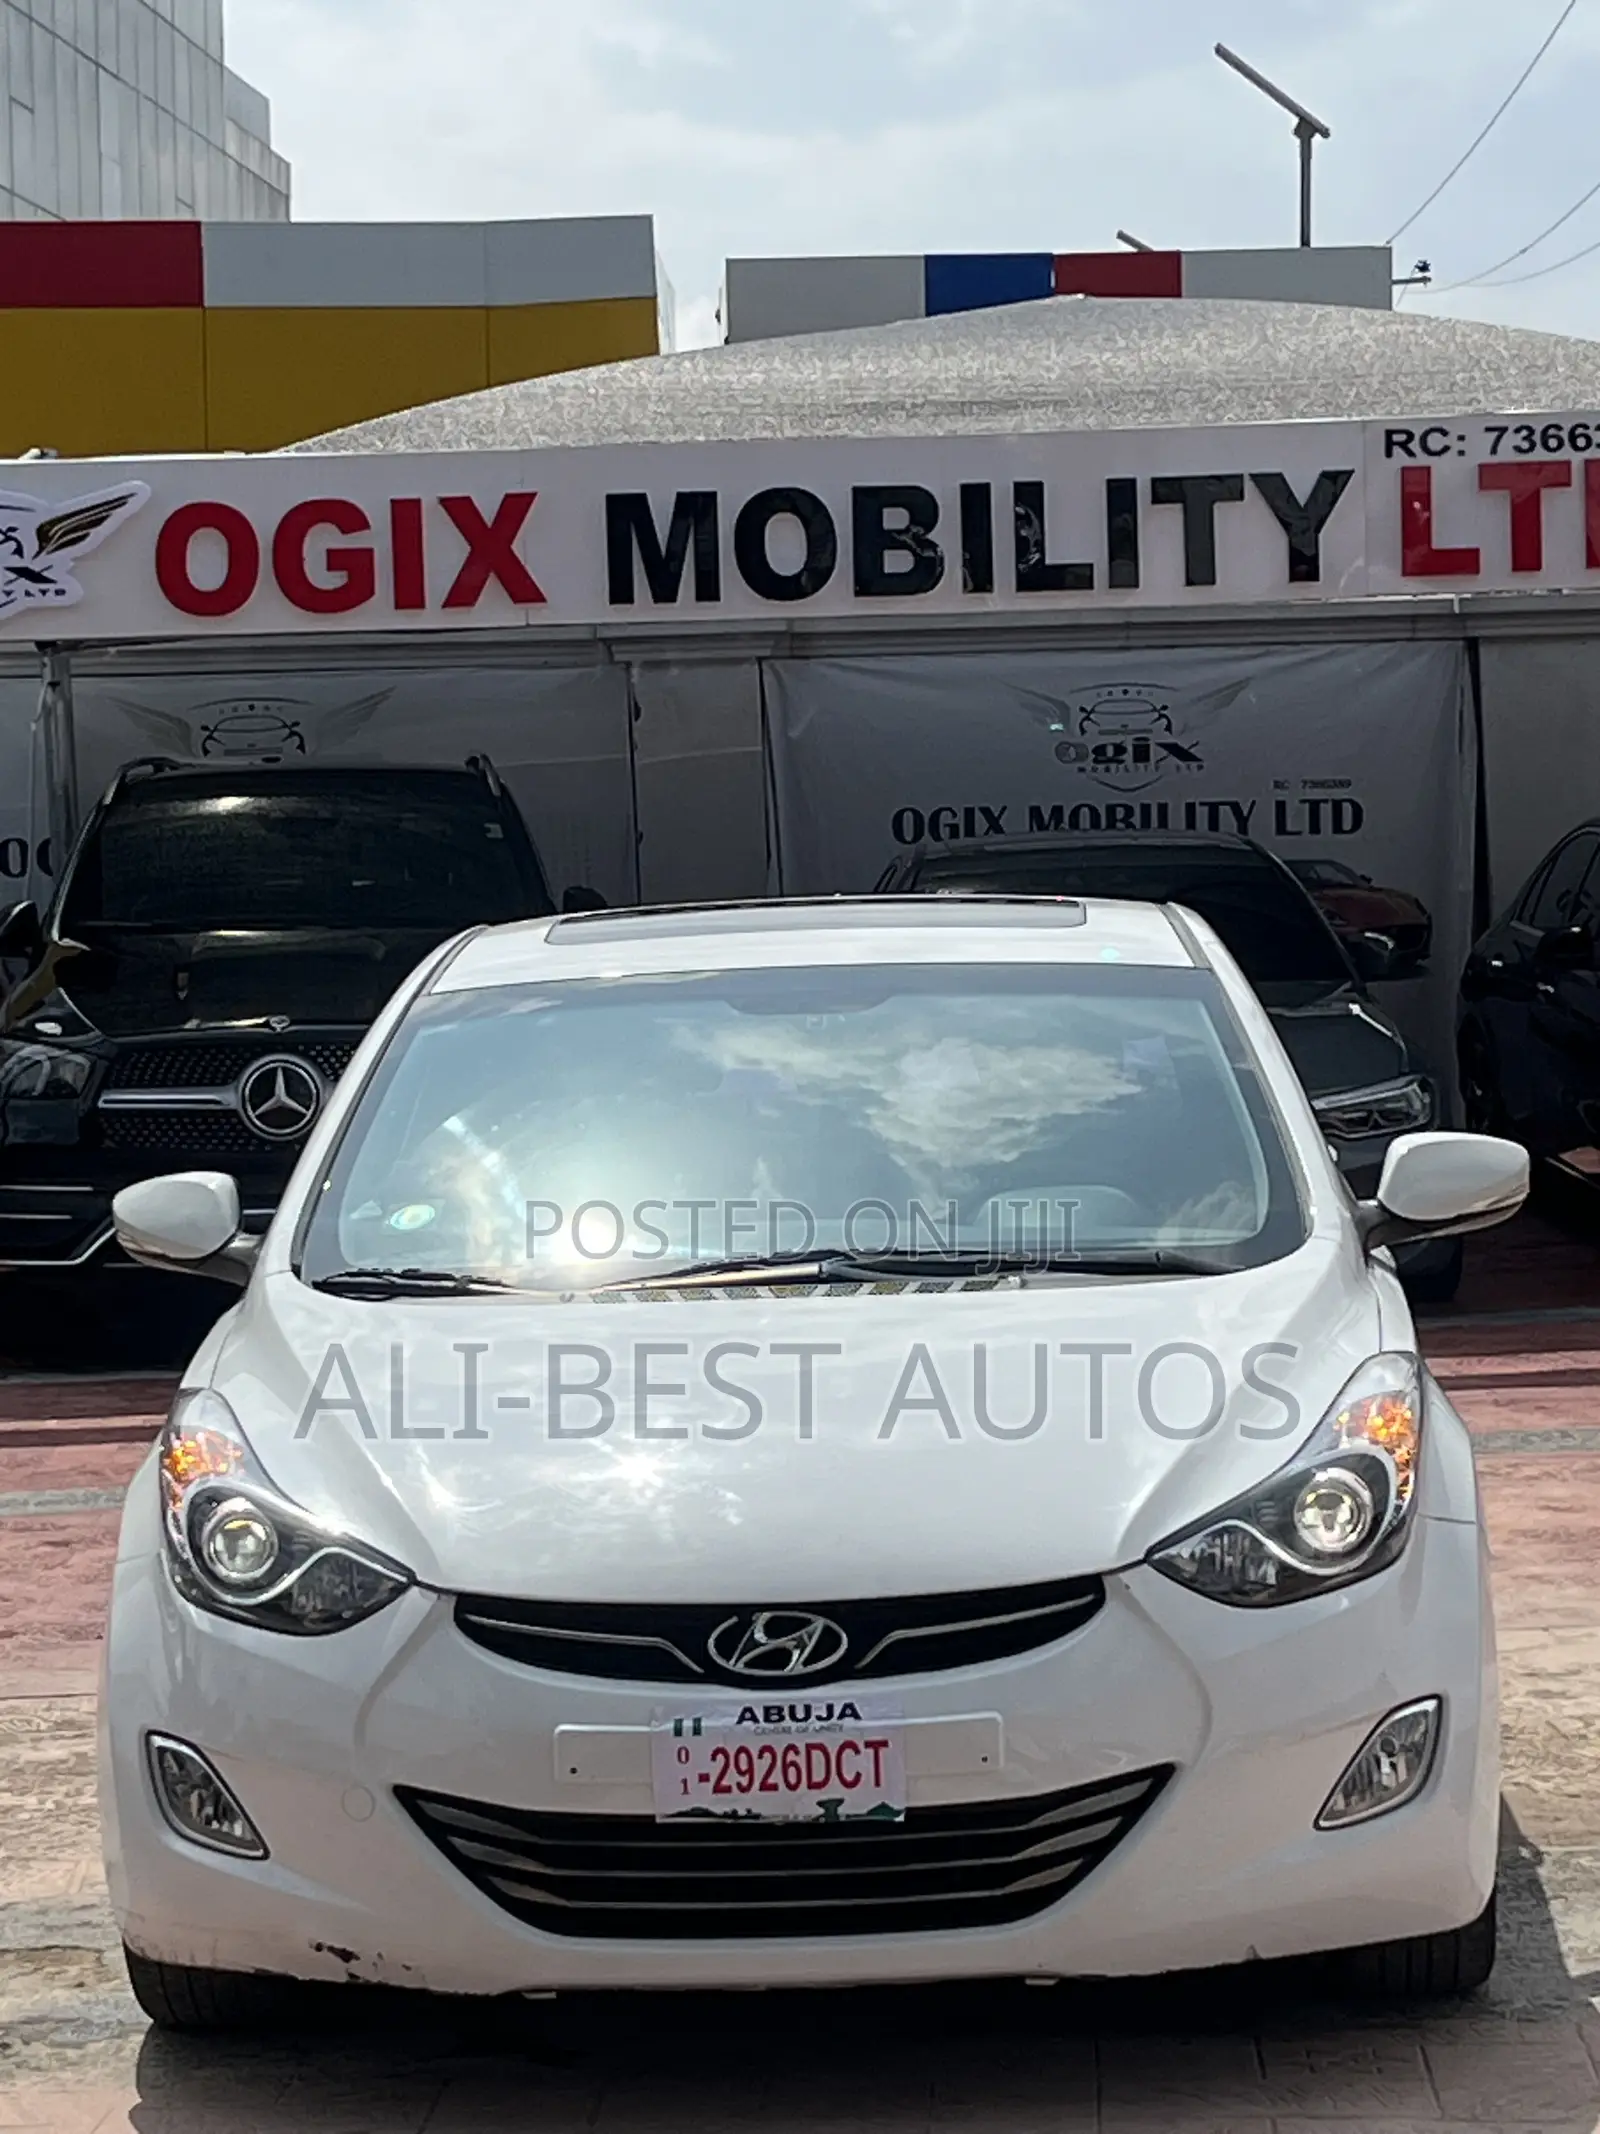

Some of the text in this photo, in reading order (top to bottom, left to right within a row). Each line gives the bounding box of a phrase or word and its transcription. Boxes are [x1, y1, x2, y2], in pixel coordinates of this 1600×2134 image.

[1385, 423, 1600, 458] RC: 7366
[155, 458, 1600, 617] OGIX MOBILITY LT
[891, 804, 1008, 845] OGIX
[1273, 797, 1365, 837] LTD
[736, 1702, 863, 1724] ABUJA
